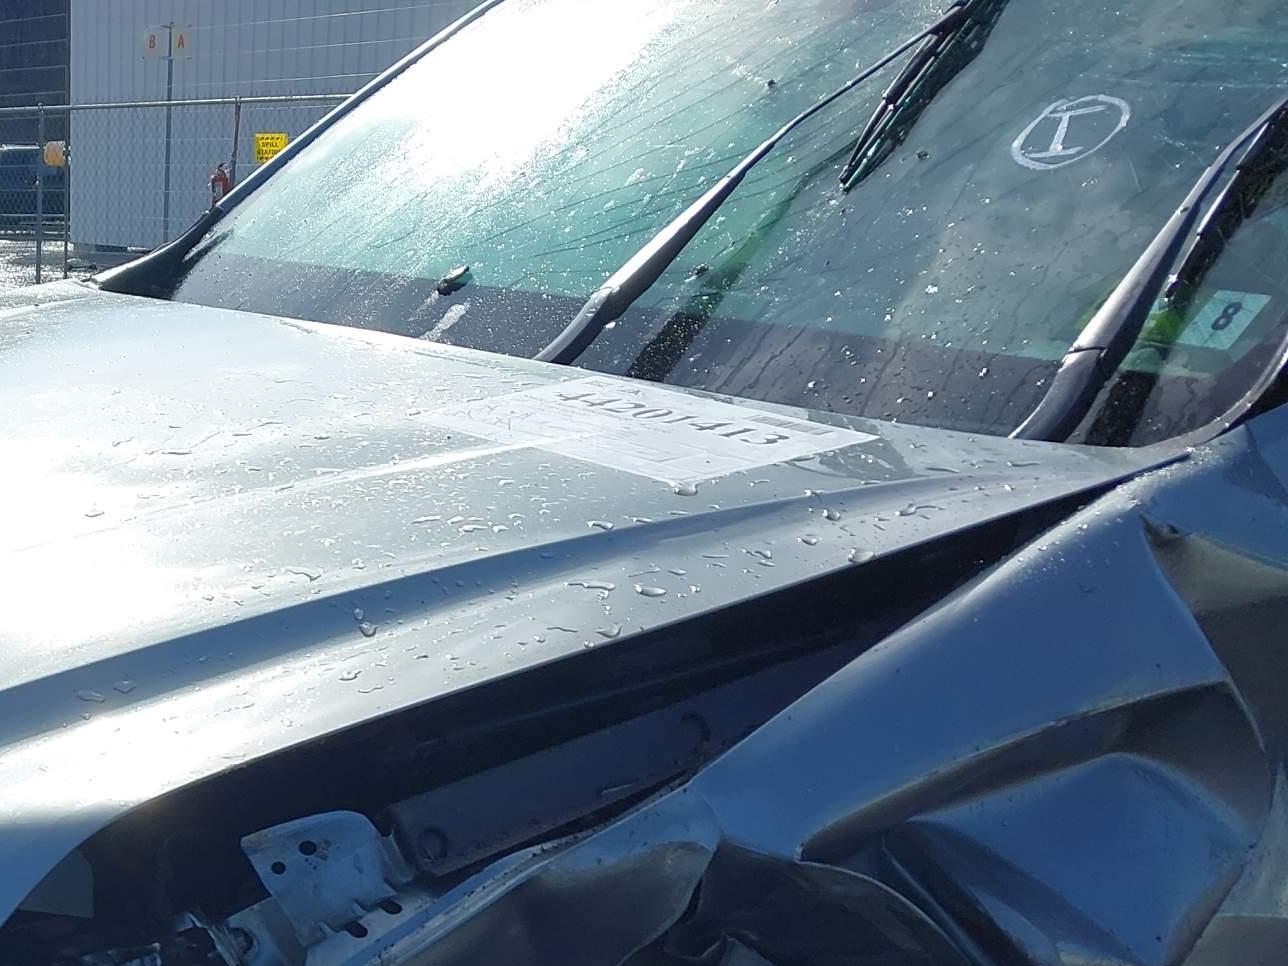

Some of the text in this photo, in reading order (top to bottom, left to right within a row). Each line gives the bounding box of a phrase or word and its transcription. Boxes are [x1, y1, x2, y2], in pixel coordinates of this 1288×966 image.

[149, 34, 156, 49] B
[177, 34, 185, 49] A
[1211, 302, 1243, 331] 8
[555, 391, 790, 445] 44201413
